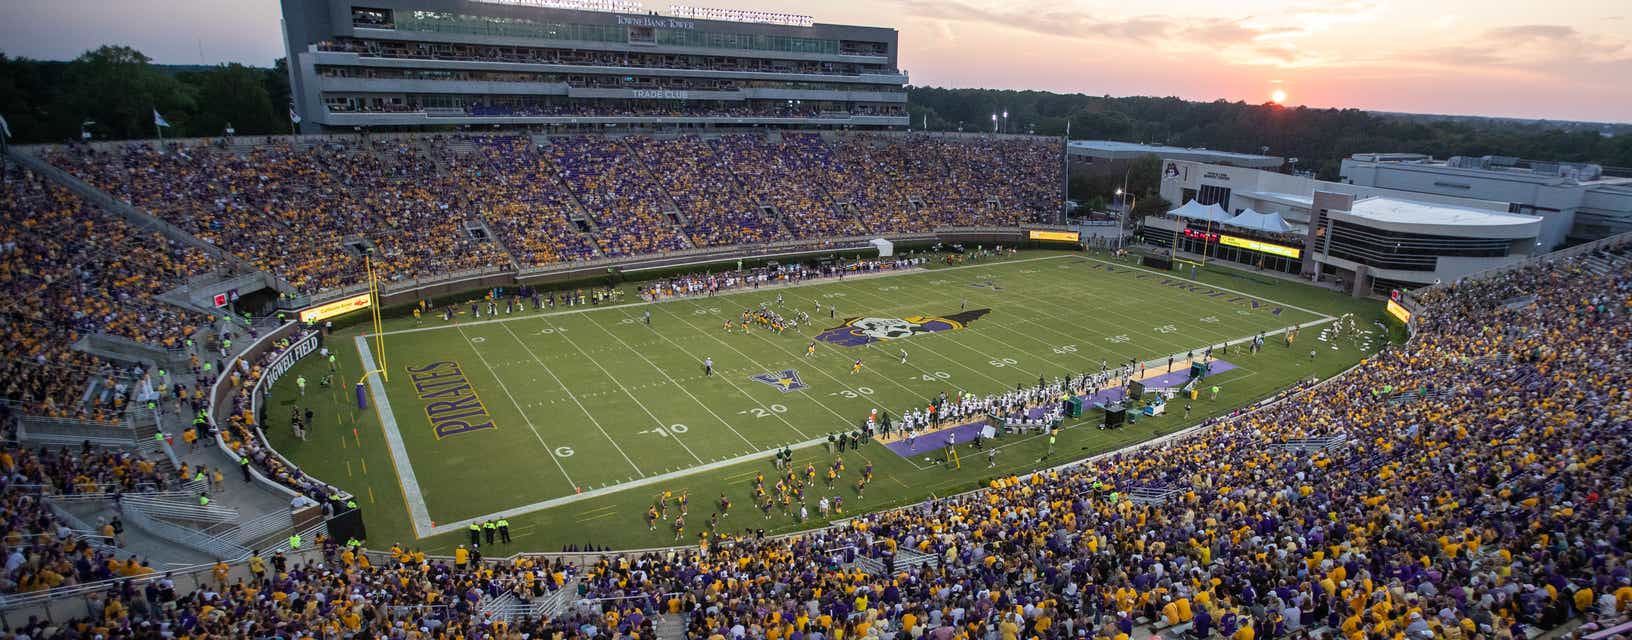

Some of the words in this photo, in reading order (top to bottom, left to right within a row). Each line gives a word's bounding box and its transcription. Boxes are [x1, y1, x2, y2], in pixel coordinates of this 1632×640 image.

[632, 90, 663, 98] TRADE
[664, 91, 688, 99] CLUB
[294, 336, 318, 361] FIELD
[988, 357, 1018, 368] 50
[922, 371, 951, 382] 40
[840, 386, 875, 399] 30
[405, 360, 498, 440] PIRATES
[750, 403, 788, 418] 20
[651, 423, 688, 437] 10
[555, 446, 575, 457] G
